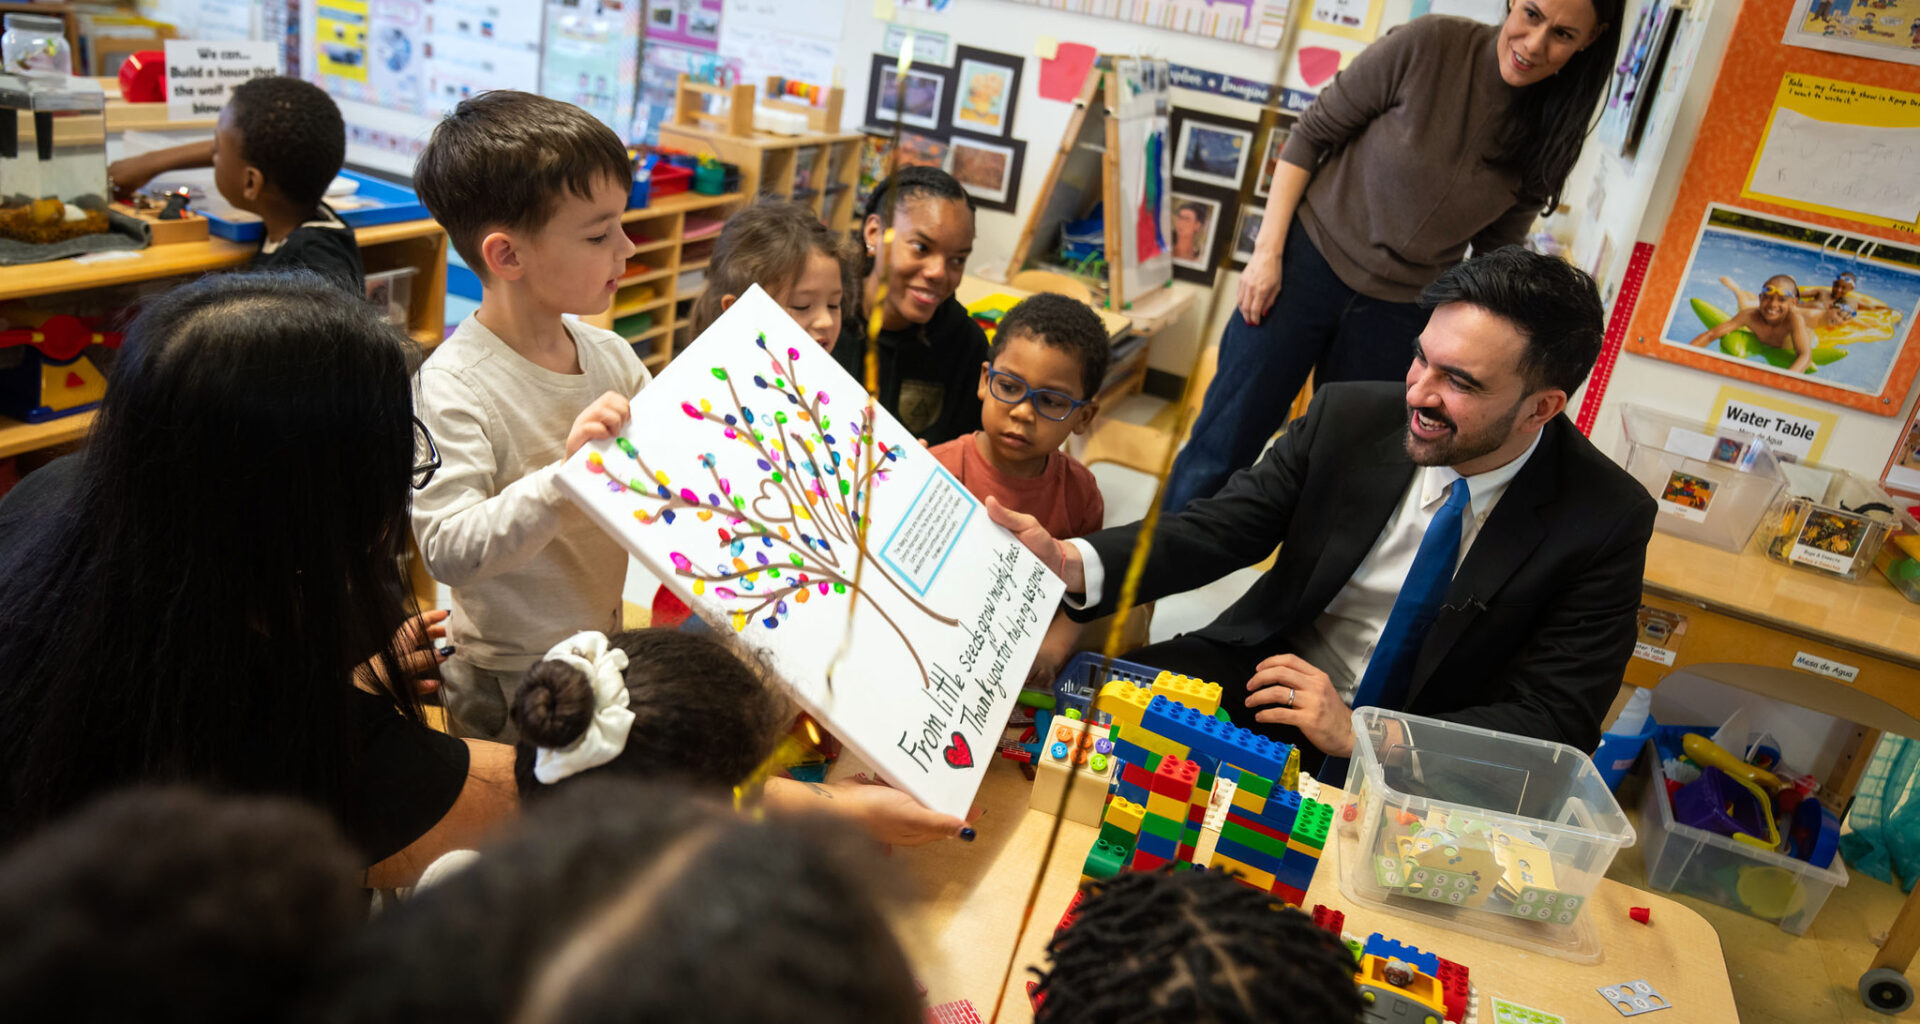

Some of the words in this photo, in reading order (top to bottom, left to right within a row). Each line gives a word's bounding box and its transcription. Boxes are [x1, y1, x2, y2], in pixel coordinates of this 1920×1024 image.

[197, 48, 216, 59] We
[170, 66, 203, 78] Build
[206, 69, 214, 77] a
[218, 66, 250, 77] house
[253, 66, 276, 77] that
[174, 85, 194, 96] the
[198, 84, 224, 95] wolf
[1220, 75, 1269, 101] Imagine
[1726, 405, 1772, 429] Water
[1775, 418, 1815, 441] Table
[1766, 435, 1784, 446] Agua
[988, 563, 1017, 602] mighty
[1022, 585, 1036, 604] us
[978, 596, 996, 642] grow
[998, 602, 1038, 645] helping
[989, 640, 1013, 663] for
[1797, 656, 1819, 668] Mesa
[1820, 663, 1831, 671] de
[1832, 667, 1853, 678] Agua
[921, 662, 965, 717] little
[986, 659, 1007, 699] you
[960, 678, 995, 736] Thank
[897, 713, 947, 773] From
